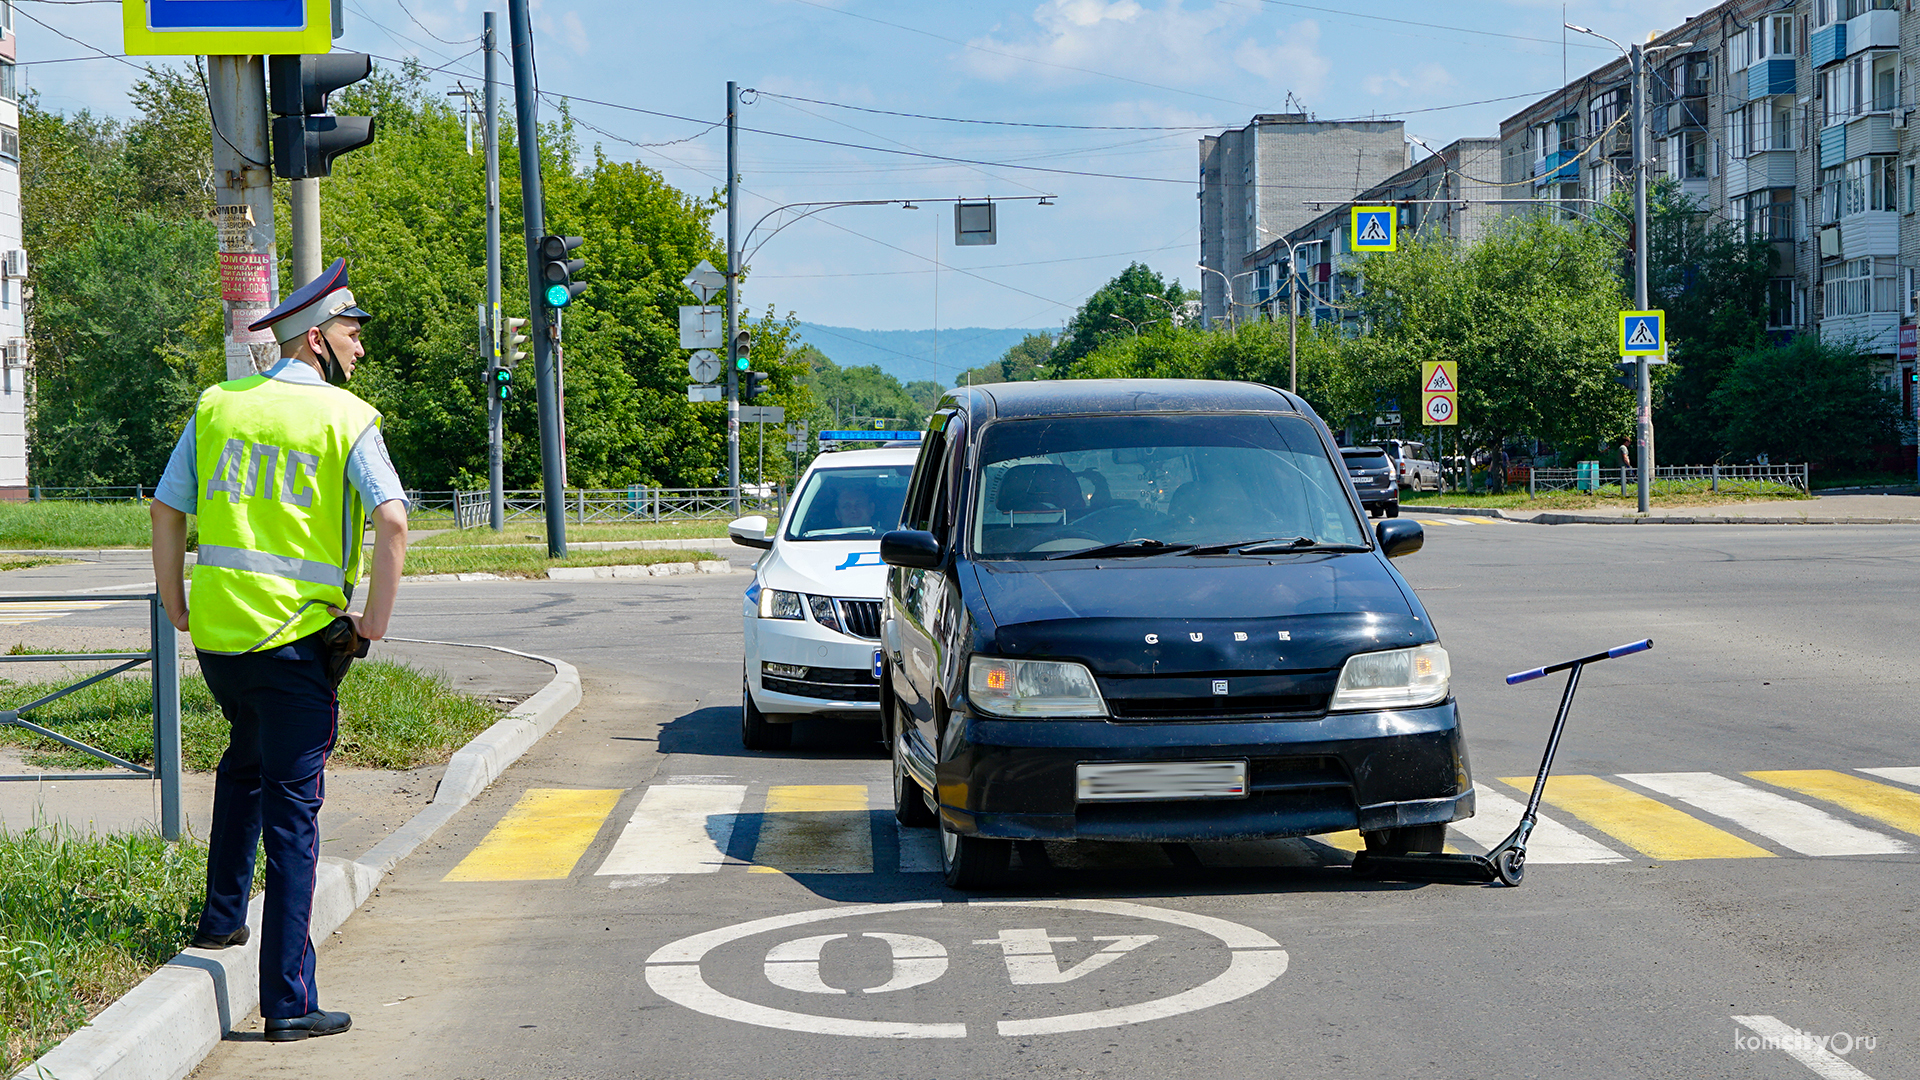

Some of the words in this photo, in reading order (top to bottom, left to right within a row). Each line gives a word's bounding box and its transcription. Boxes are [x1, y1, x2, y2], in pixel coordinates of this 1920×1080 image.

[1432, 403, 1449, 414] 40
[206, 438, 320, 509] ДПС
[1144, 630, 1291, 645] CUBE
[763, 927, 1160, 995] 40
